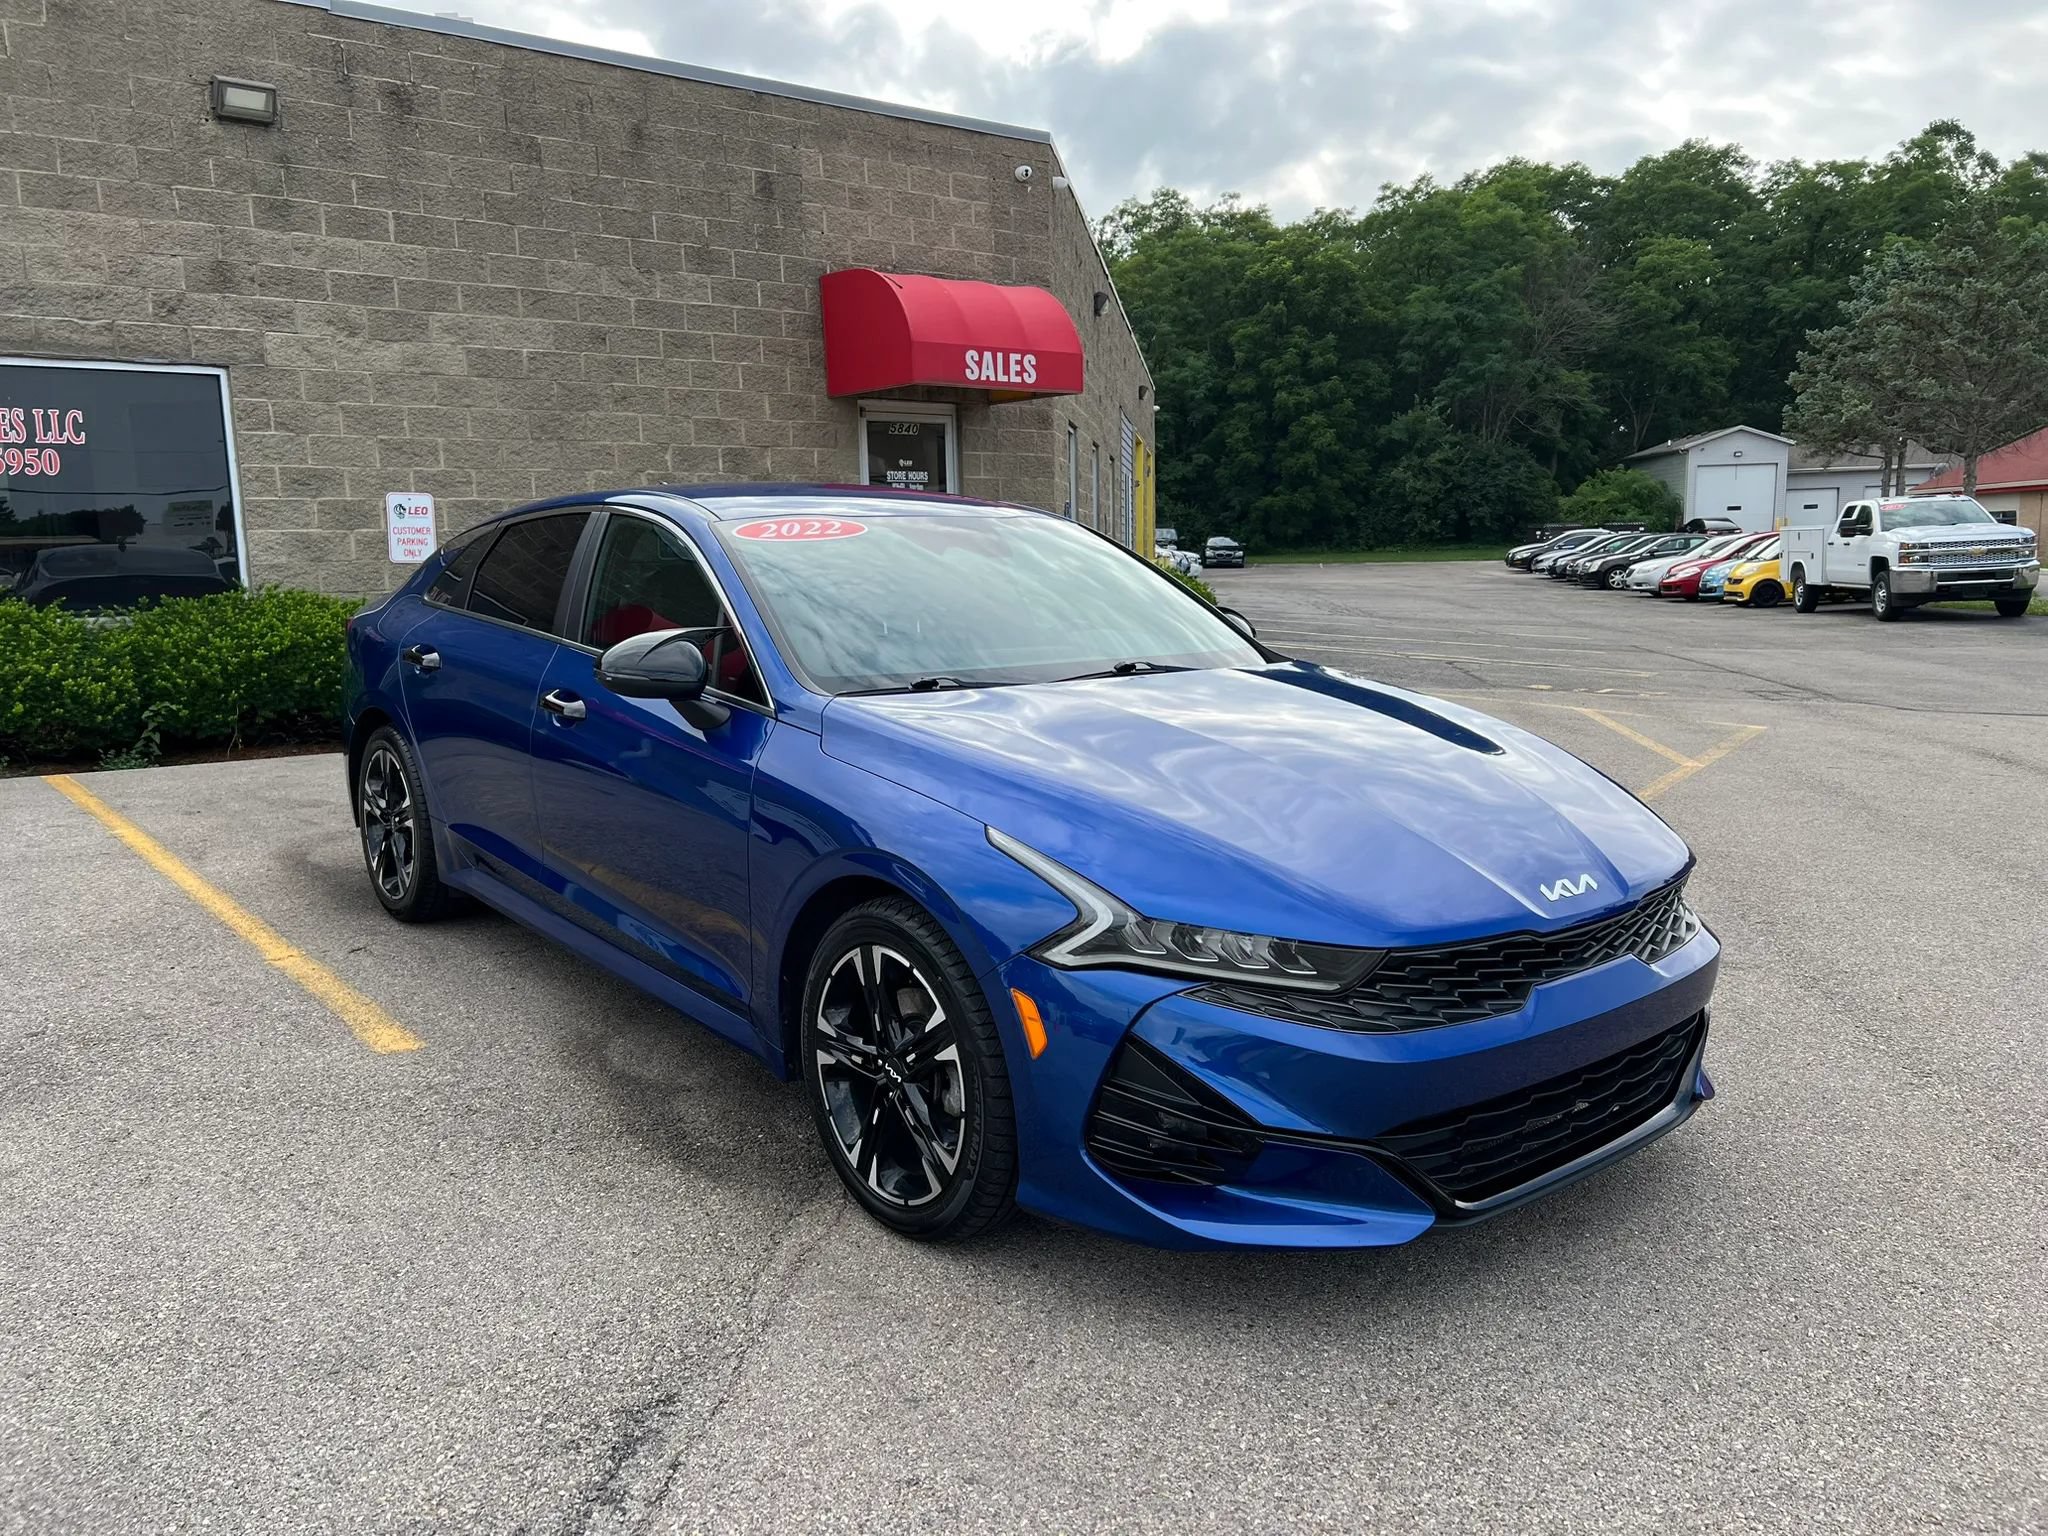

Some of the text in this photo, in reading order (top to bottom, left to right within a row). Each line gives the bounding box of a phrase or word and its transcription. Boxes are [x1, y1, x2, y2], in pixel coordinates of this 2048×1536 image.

[965, 349, 1037, 384] SALES
[0, 408, 85, 444] ES LLC
[890, 423, 919, 434] 5840
[886, 471, 928, 480] STORE HOURS
[408, 506, 428, 515] LEO
[393, 527, 431, 535] CUSTOMER
[760, 521, 842, 538] 2022
[397, 538, 428, 546] PARKING
[404, 548, 422, 557] ONLY
[1540, 873, 1598, 902] KIA
